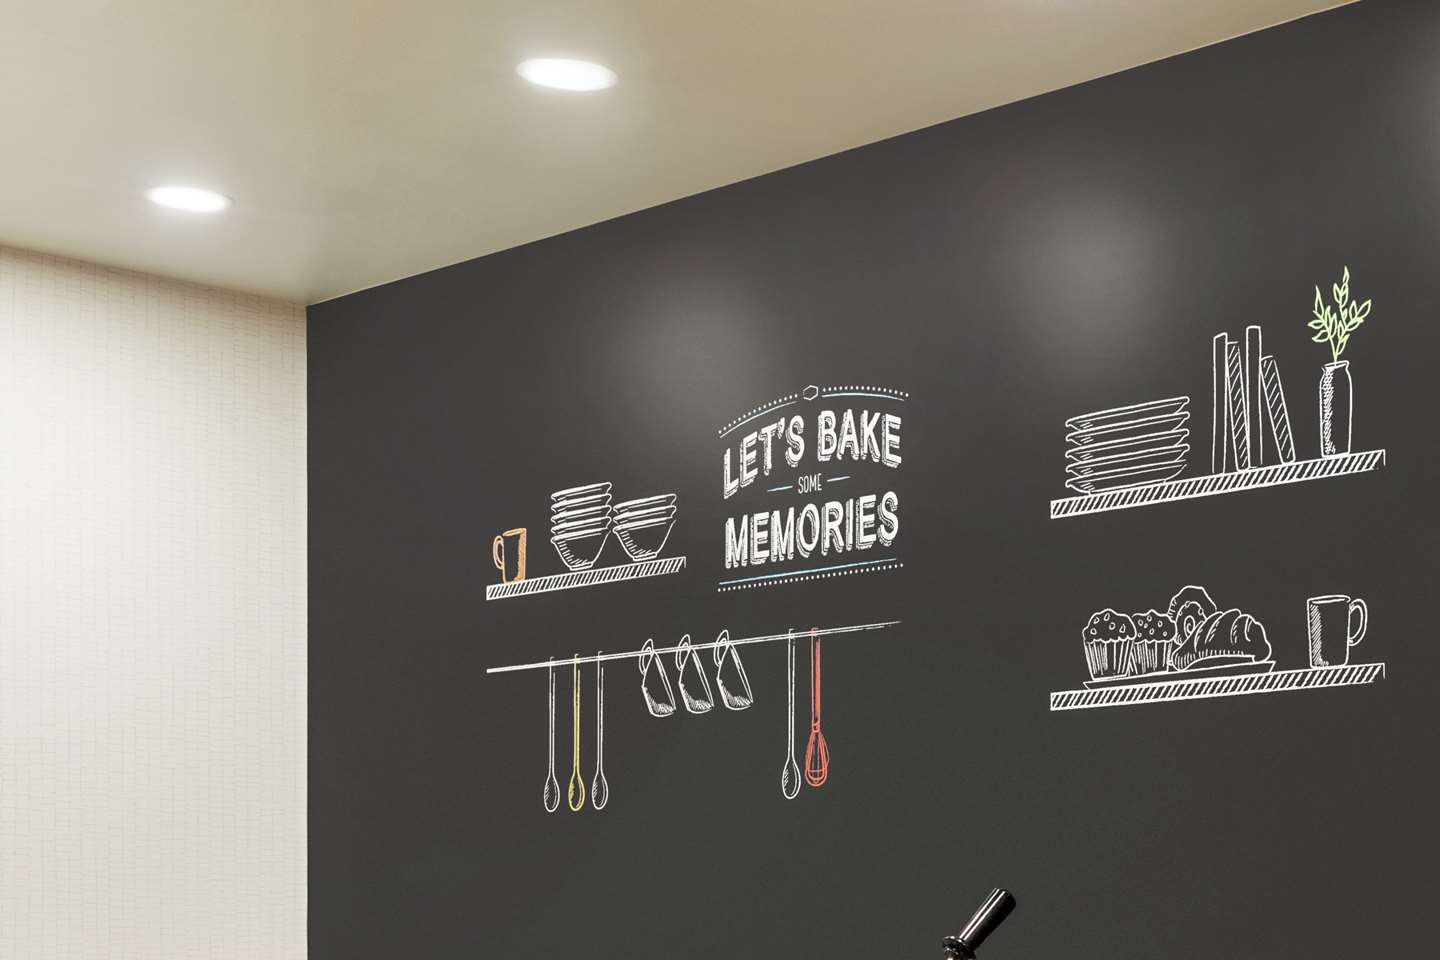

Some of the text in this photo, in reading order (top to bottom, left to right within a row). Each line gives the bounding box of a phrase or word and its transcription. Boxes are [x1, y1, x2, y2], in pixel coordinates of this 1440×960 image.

[724, 409, 902, 499] LET'S BAKE
[798, 472, 823, 494] SOME
[725, 491, 899, 568] MEMORIES
